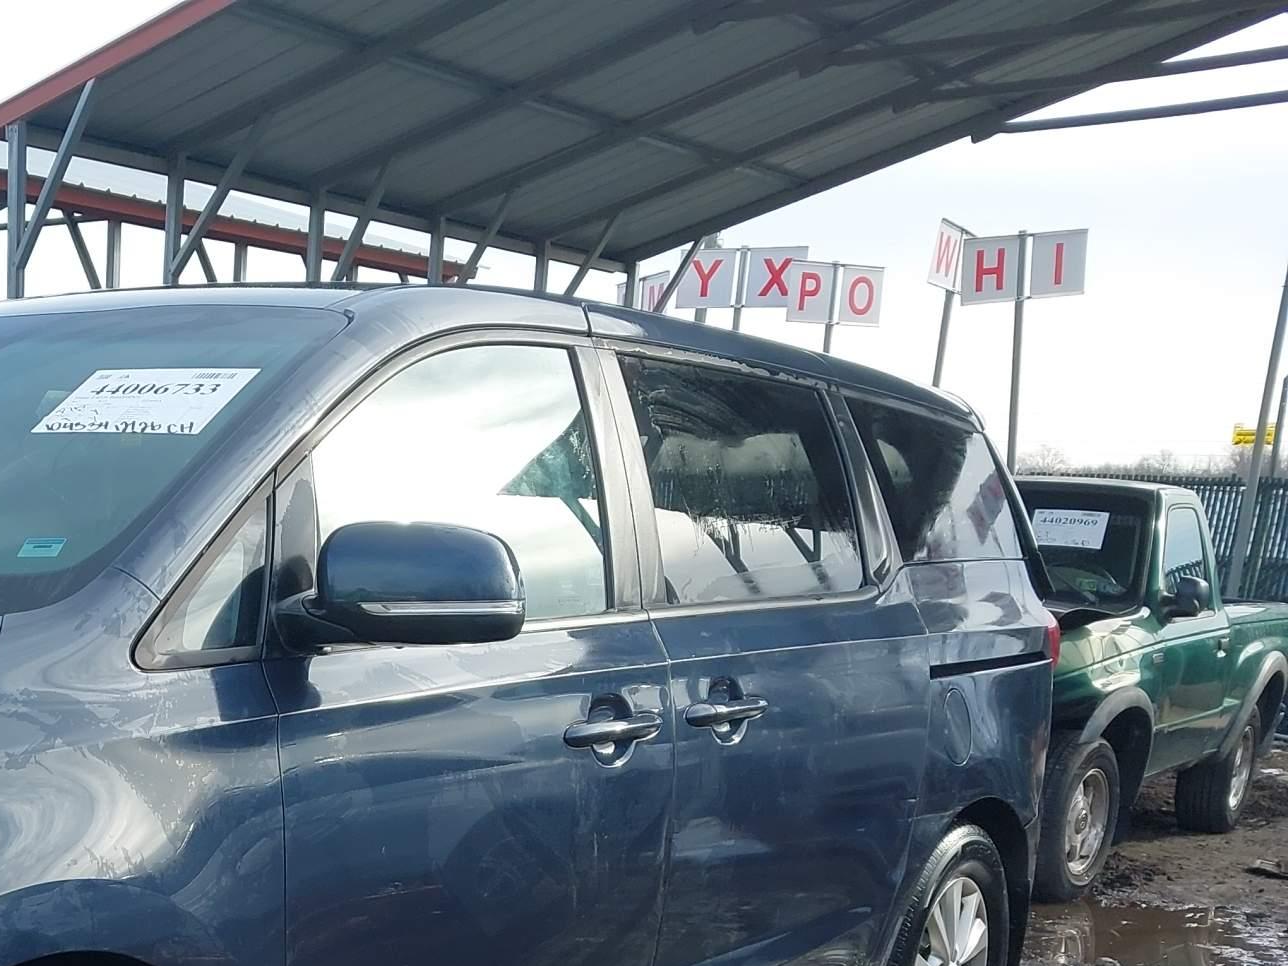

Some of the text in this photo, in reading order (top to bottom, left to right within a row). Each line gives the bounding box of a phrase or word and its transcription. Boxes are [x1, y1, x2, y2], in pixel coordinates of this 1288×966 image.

[935, 231, 958, 277] W
[975, 242, 1064, 292] H I
[692, 257, 793, 297] Y X
[798, 271, 874, 316] P O
[91, 383, 221, 395] 44006733
[167, 421, 194, 434] CH
[1040, 516, 1098, 527] 44020969
